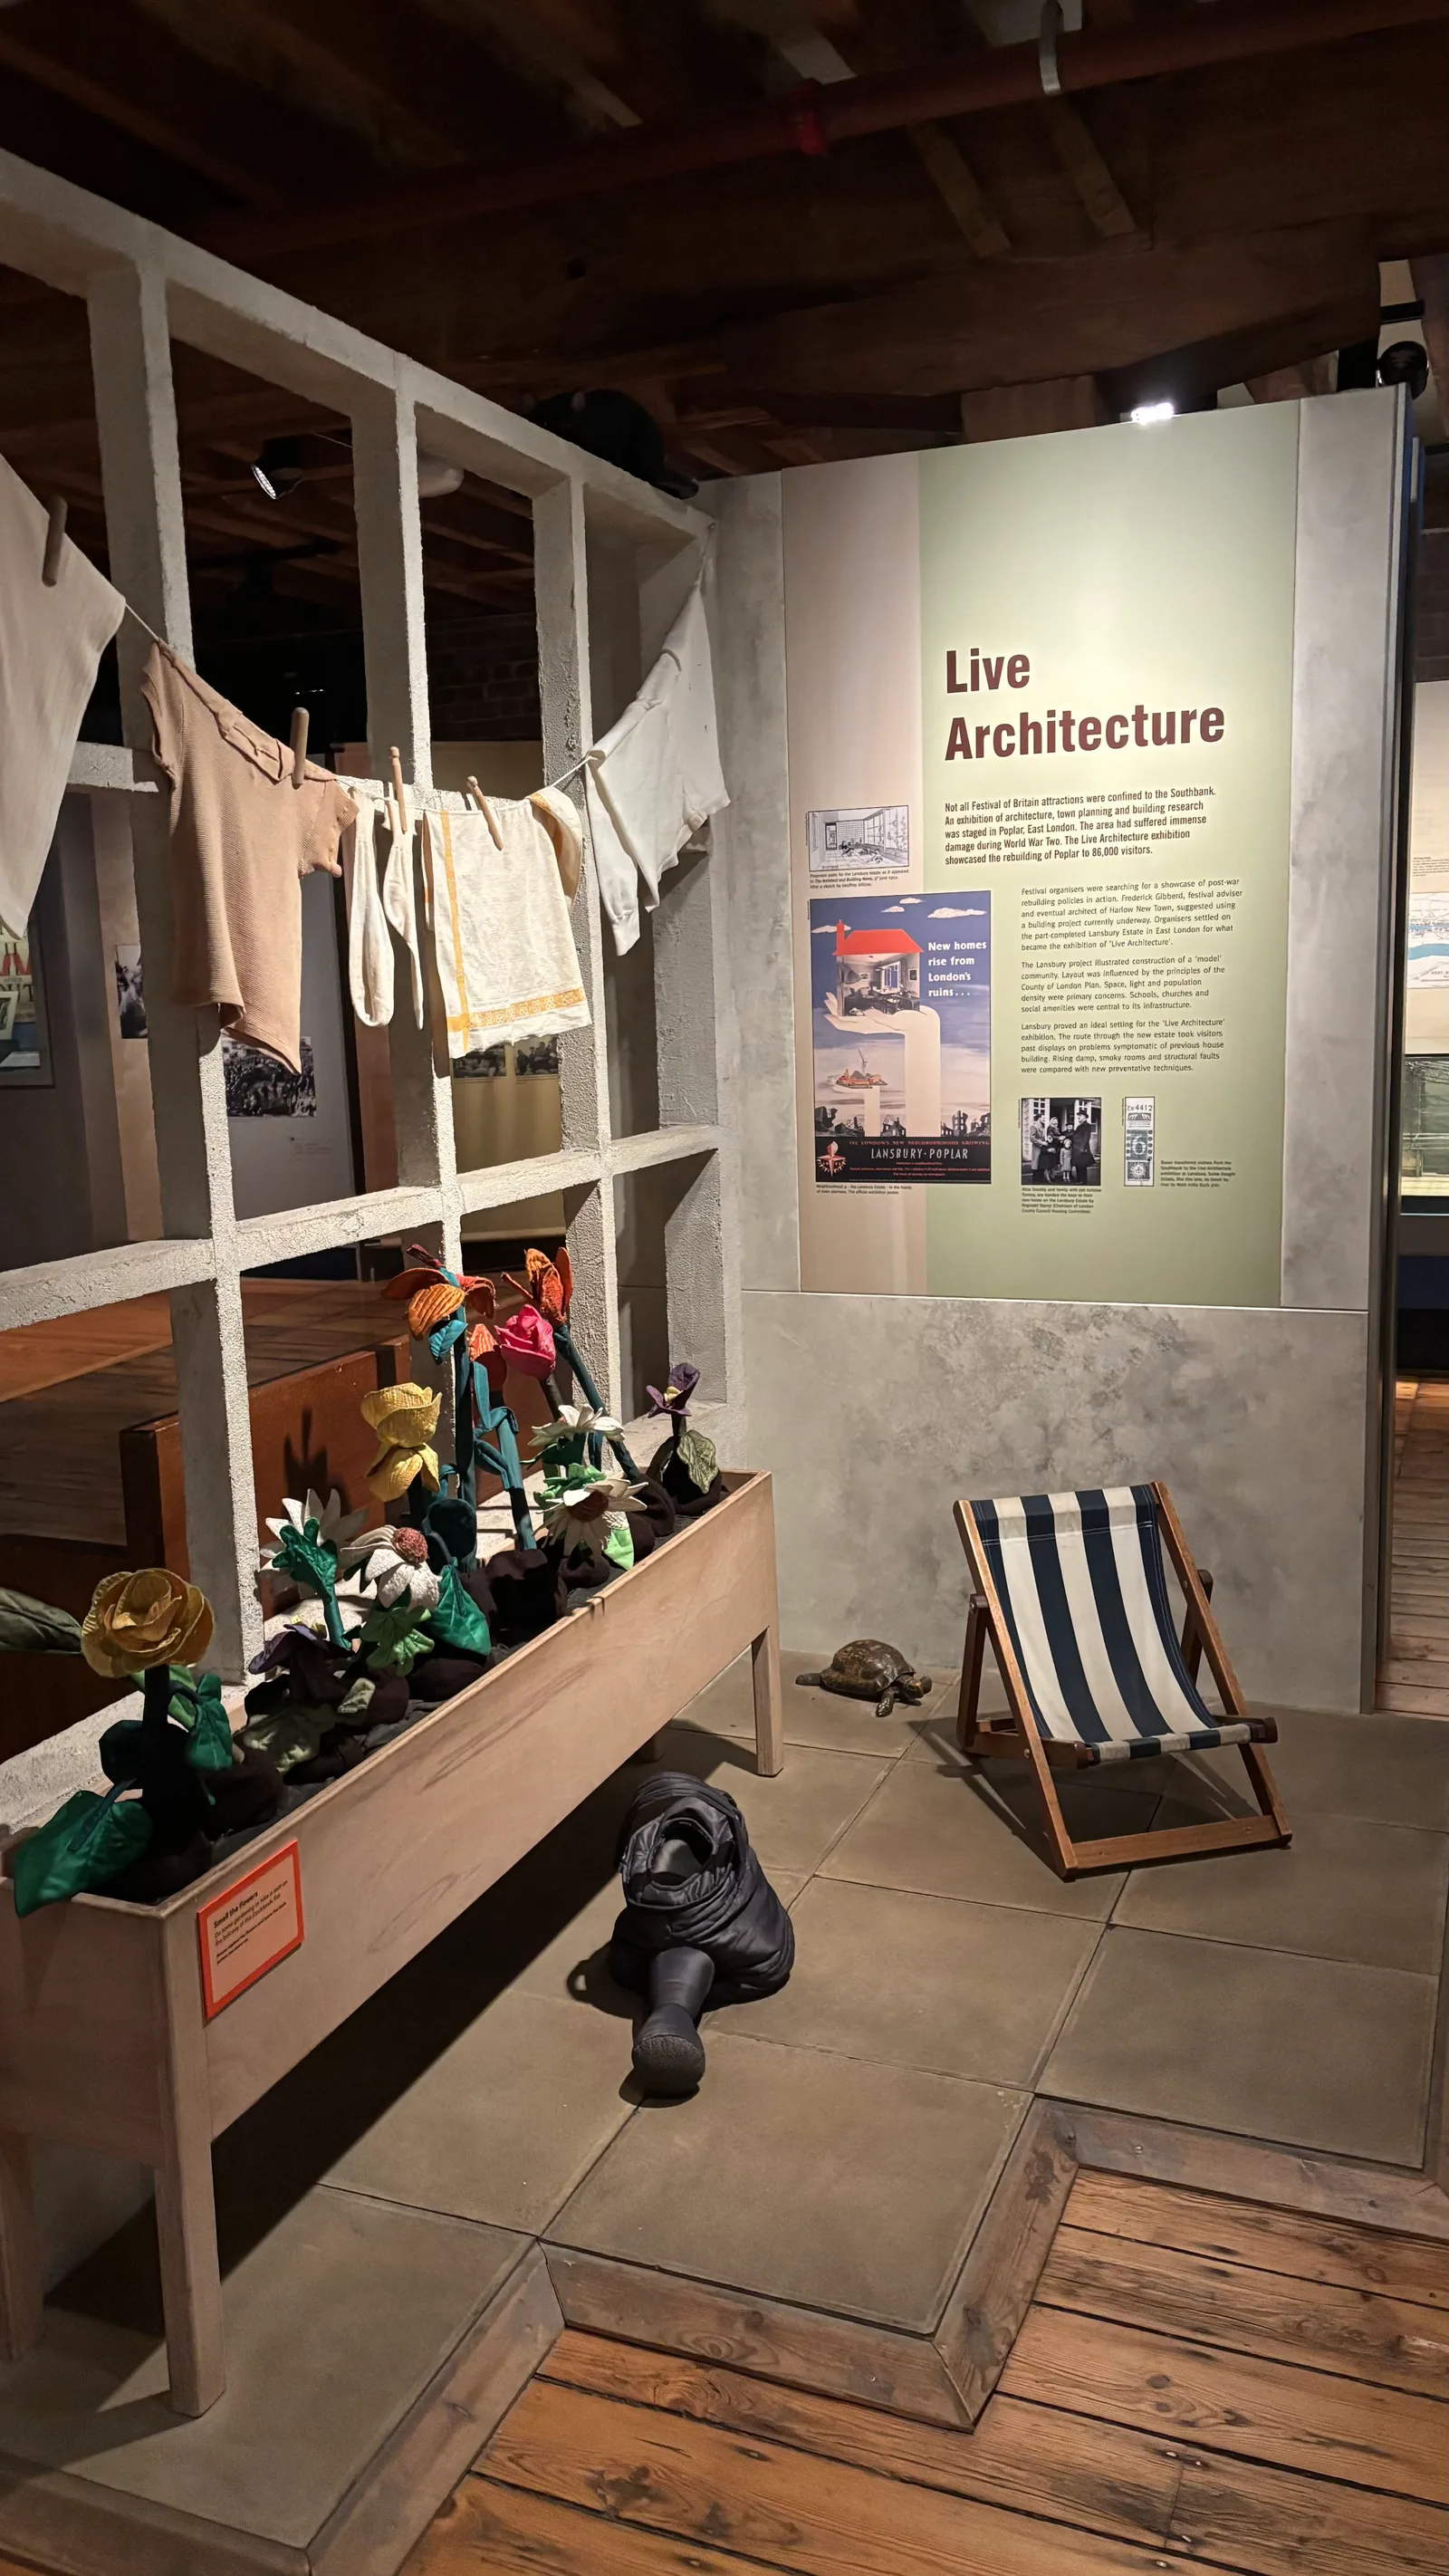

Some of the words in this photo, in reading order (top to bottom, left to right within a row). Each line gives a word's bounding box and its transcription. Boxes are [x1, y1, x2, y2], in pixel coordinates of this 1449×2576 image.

[947, 649, 1029, 693] Live
[945, 706, 1223, 760] Architecture
[945, 803, 958, 812] Not
[960, 802, 969, 812] all
[972, 800, 1001, 811] Festival
[1003, 799, 1011, 809] of
[1013, 797, 1040, 808] Britain
[1041, 795, 1084, 806] attractions
[1108, 790, 1142, 802] confined
[1145, 791, 1153, 800] to
[1155, 790, 1168, 799] the
[1170, 786, 1216, 798] Southbank.
[945, 816, 955, 825] An
[956, 814, 993, 825] exhibition
[995, 812, 1003, 822] of
[1005, 812, 1055, 822] architecture,
[1057, 810, 1076, 819] town
[1079, 807, 1113, 819] planning
[1115, 805, 1130, 815] and
[1133, 803, 1166, 814] building
[1167, 801, 1204, 812] research
[945, 831, 960, 839] was
[962, 827, 987, 839] staged
[989, 827, 996, 836] in
[999, 825, 1025, 837] Poplar,
[1028, 824, 1044, 834] East
[1046, 822, 1078, 832] London.
[1080, 821, 1094, 831] The
[1096, 822, 1114, 830] area
[1117, 818, 1131, 829] had
[1134, 816, 1167, 828] suffered
[1170, 816, 1206, 825] immense
[945, 842, 974, 852] damage
[977, 841, 1002, 851] during
[1003, 838, 1026, 848] World
[1028, 837, 1044, 847] War
[1045, 836, 1062, 846] Two.
[1065, 835, 1079, 845] The
[1081, 834, 1098, 844] Live
[1099, 832, 1148, 843] Architecture
[1151, 830, 1190, 841] exhibition
[945, 853, 986, 865] showcased
[989, 853, 1001, 862] the
[1003, 851, 1042, 862] rebuilding
[1044, 850, 1052, 860] of
[1054, 849, 1080, 860] Poplar
[1082, 849, 1089, 858] to
[1092, 846, 1118, 857] 86,000
[1121, 845, 1153, 855] visitors.
[1049, 886, 1084, 895] organisers
[1106, 883, 1139, 891] searching
[1141, 881, 1151, 889] for
[1197, 879, 1206, 887] of
[1208, 879, 1240, 888] post-war
[1022, 899, 1055, 907] rebuilding
[1058, 897, 1084, 906] policies
[1121, 893, 1153, 902] Frederick
[1155, 891, 1185, 900] Gibberd,
[1188, 890, 1214, 899] festival
[1216, 889, 1243, 898] adviser
[1036, 908, 1066, 917] eventual
[1068, 908, 1097, 916] architect
[1153, 904, 1175, 912] Town,
[1176, 902, 1214, 912] suggested
[1216, 901, 1235, 909] using
[1028, 921, 1056, 929] building
[1058, 919, 1081, 928] project
[1084, 918, 1114, 927] currently
[1117, 917, 1151, 925] underway.
[1154, 915, 1192, 925] Organisers
[1194, 913, 1219, 922] settled
[1034, 930, 1086, 940] part-completed
[1089, 929, 1120, 937] Lansbury
[1156, 927, 1171, 935] East
[1174, 926, 1200, 934] London
[1203, 925, 1214, 933] for
[928, 942, 951, 951] New
[955, 941, 987, 950] homes
[1063, 941, 1097, 949] exhibition
[1099, 940, 1108, 948] of
[1127, 938, 1173, 947] Architecture'.
[928, 957, 947, 966] rise
[950, 956, 974, 966] from
[1036, 961, 1067, 969] Lansbury
[1069, 959, 1092, 968] project
[1132, 956, 1176, 965] construction
[1177, 956, 1185, 964] of
[928, 972, 971, 982] London's
[1021, 972, 1059, 980] community.
[1061, 971, 1085, 979] Layout
[1103, 968, 1139, 976] influenced
[1141, 968, 1150, 976] by
[1166, 967, 1201, 976] principles
[1203, 966, 1212, 974] of
